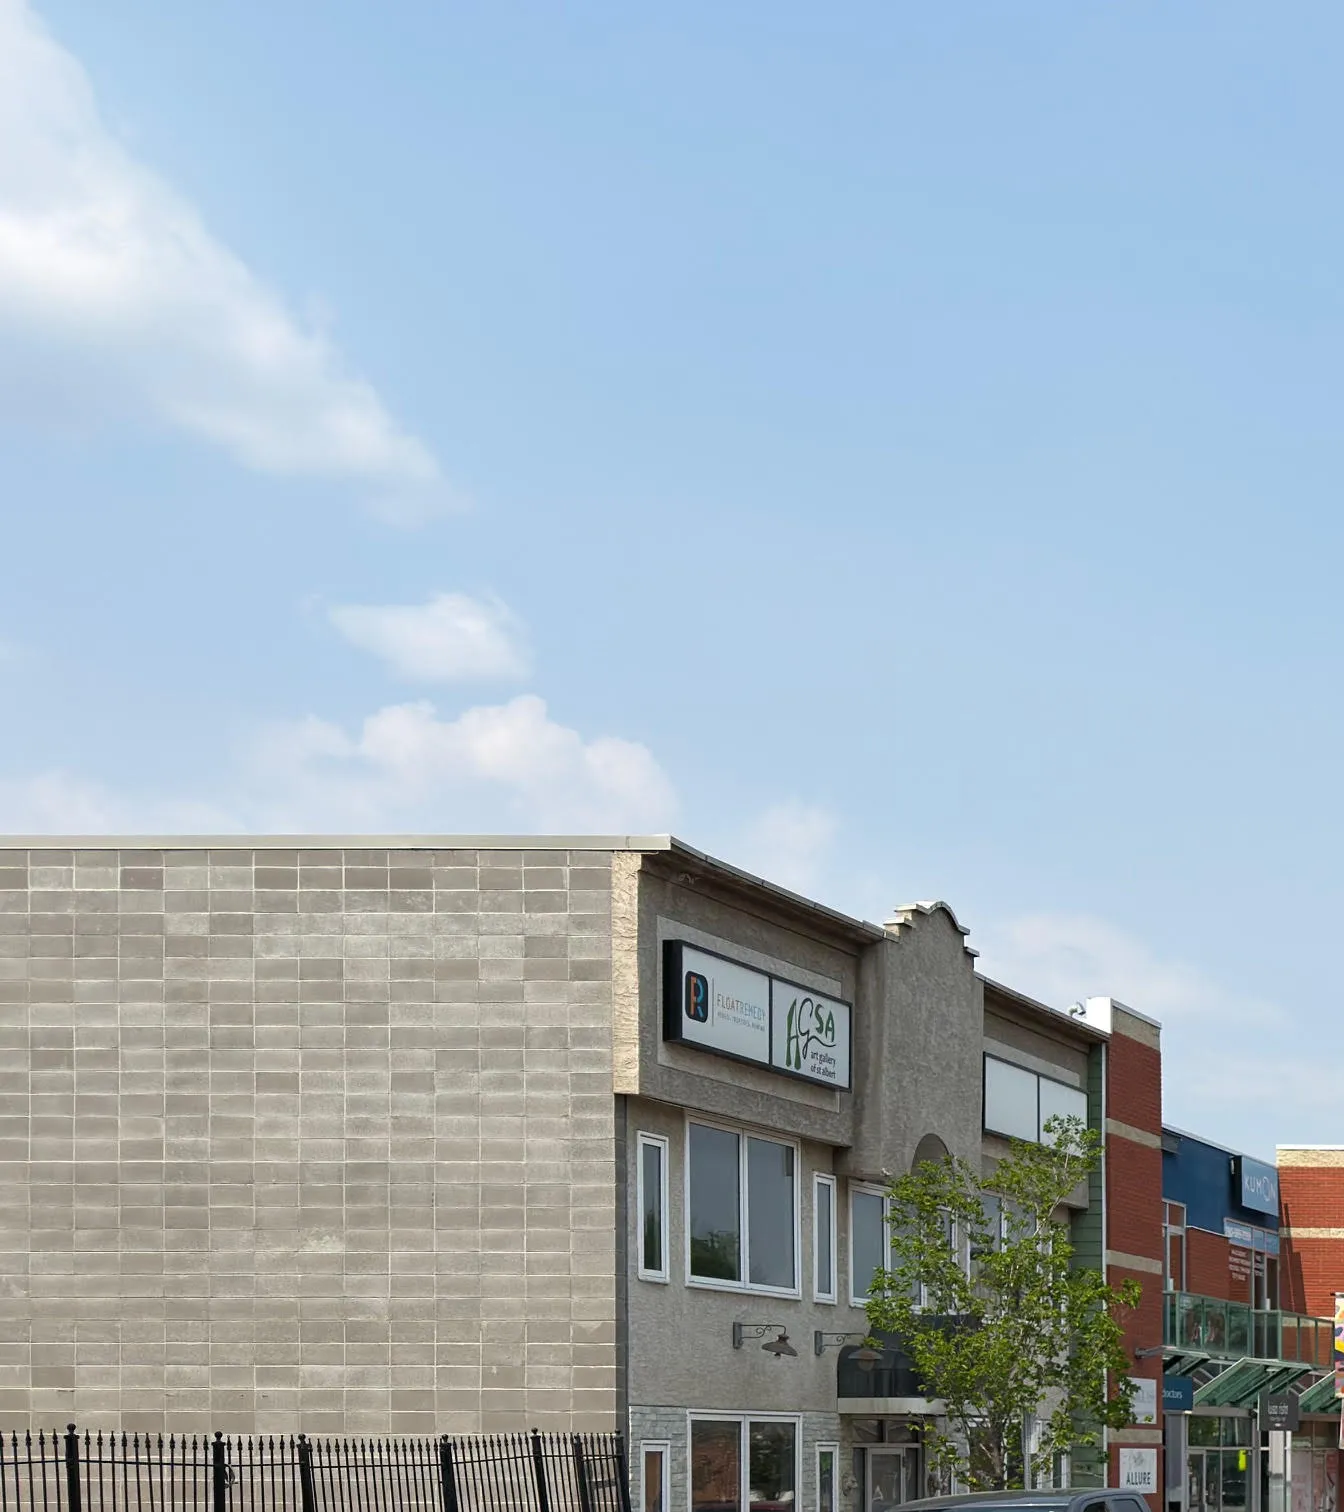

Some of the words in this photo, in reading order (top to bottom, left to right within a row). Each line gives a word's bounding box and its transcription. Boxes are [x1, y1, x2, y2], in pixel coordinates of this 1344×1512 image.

[810, 1051, 818, 1060] art
[819, 1053, 836, 1068] gallery
[1244, 1176, 1276, 1202] KUMON
[1126, 1472, 1151, 1486] ALLURE
